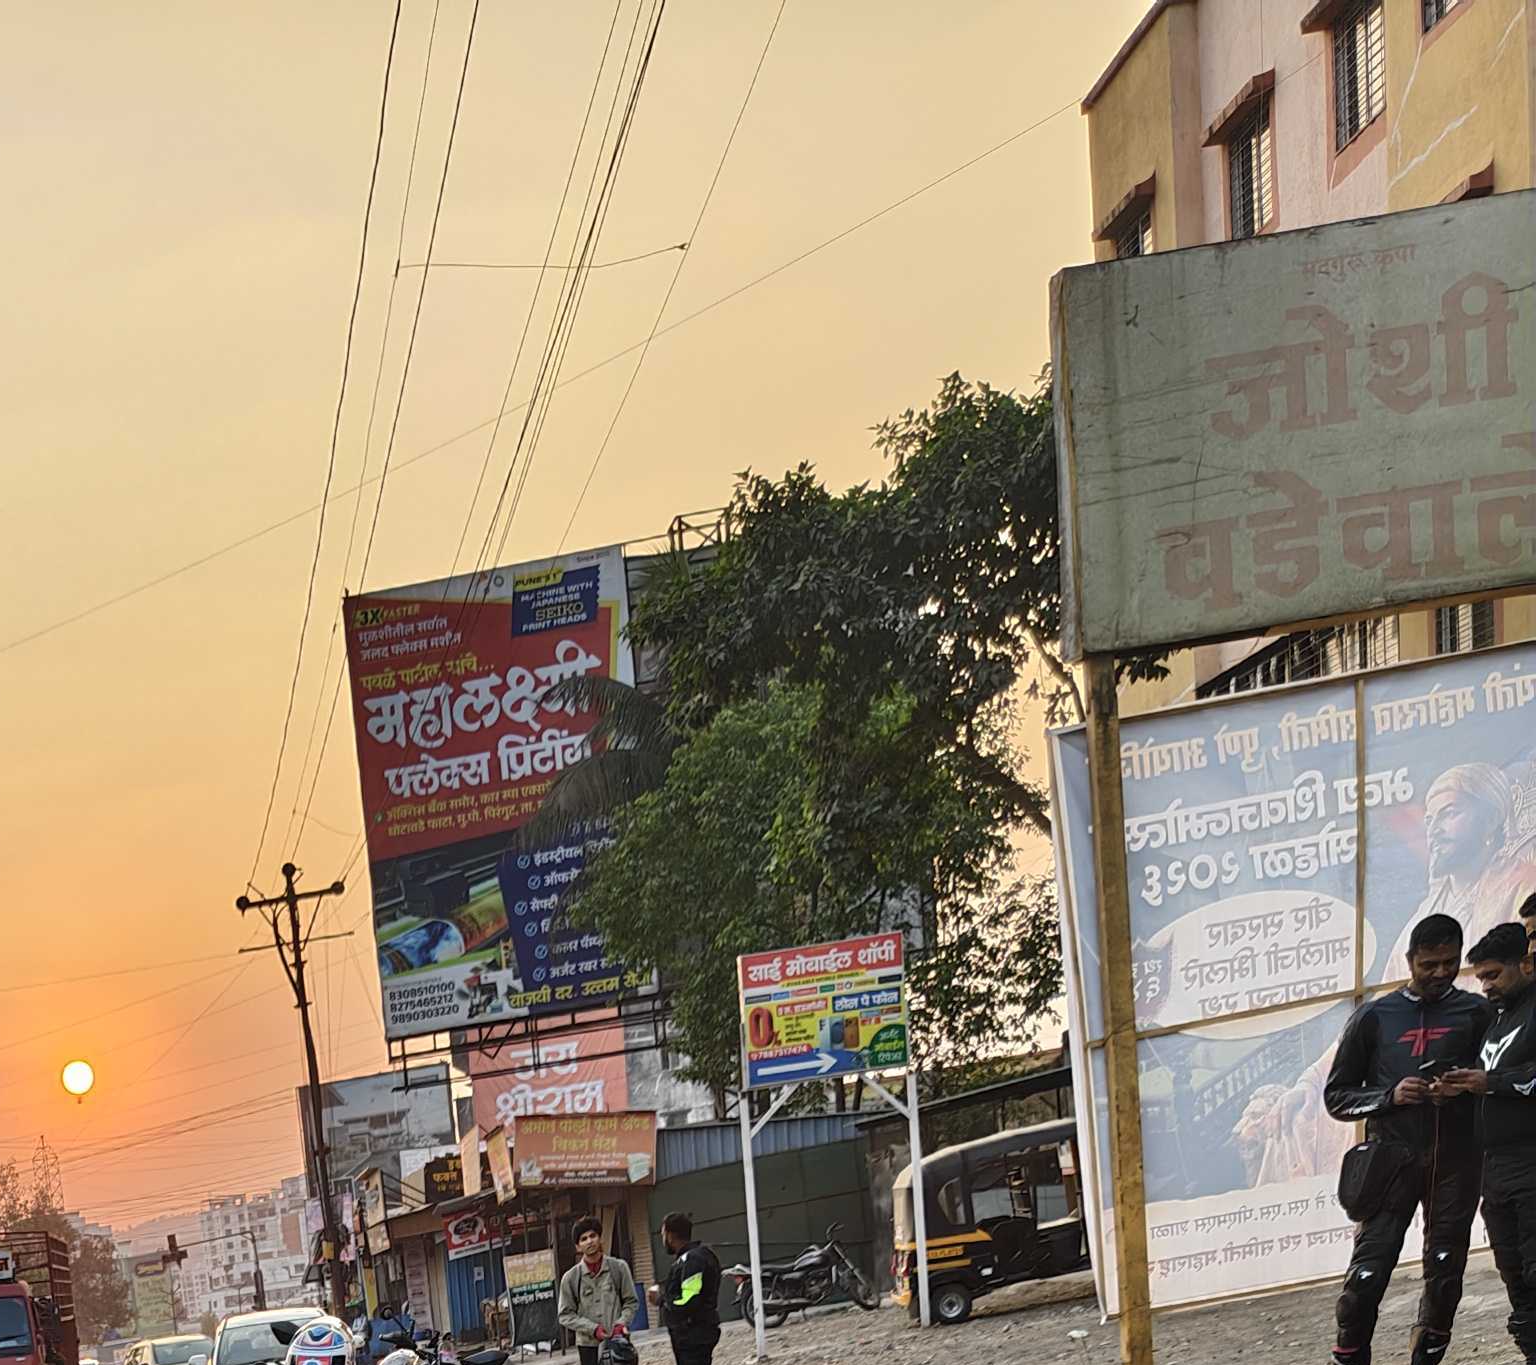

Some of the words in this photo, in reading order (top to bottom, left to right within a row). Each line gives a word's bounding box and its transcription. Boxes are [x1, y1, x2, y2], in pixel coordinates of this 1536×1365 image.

[1205, 272, 1518, 439] जोशी
[531, 592, 581, 609] JAPANESE
[566, 581, 593, 594] WITH
[522, 618, 551, 632] PRINT
[552, 613, 587, 628] HEADS
[535, 602, 584, 621] SEIKO
[384, 752, 490, 799] फ्लेक्स
[747, 957, 782, 982] साई
[785, 948, 853, 977] मोबाईल
[857, 940, 897, 964] शॉपी
[510, 1040, 581, 1080] जय
